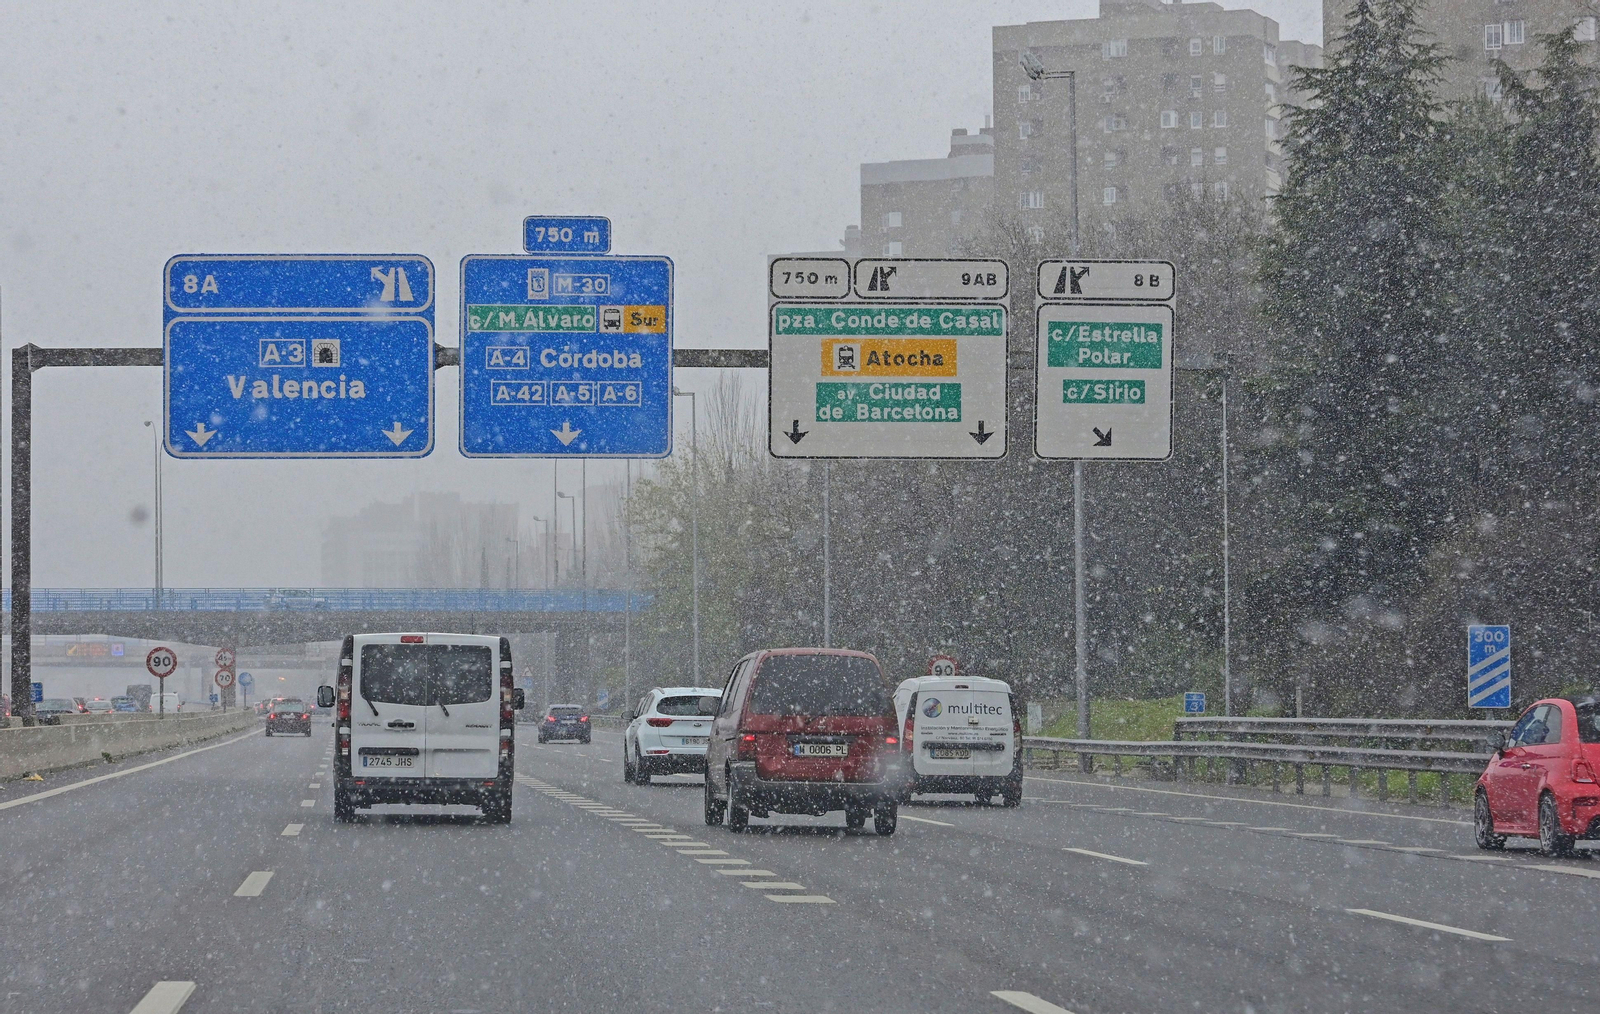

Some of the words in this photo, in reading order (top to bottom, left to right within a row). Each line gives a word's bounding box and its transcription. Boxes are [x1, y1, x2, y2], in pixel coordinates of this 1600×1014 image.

[535, 227, 573, 243] 750
[584, 231, 600, 244] m
[183, 275, 219, 294] 8A
[557, 278, 606, 292] M-30
[782, 272, 819, 284] 750
[824, 275, 838, 284] m
[961, 273, 997, 285] 9AB
[630, 312, 659, 327] Sur
[831, 312, 899, 328] Conde
[905, 312, 931, 328] de
[939, 312, 1000, 329] Casal
[263, 343, 303, 363] A-3
[489, 351, 526, 366] A-4
[540, 346, 642, 368] Córdoba
[866, 350, 944, 366] Atocha
[1078, 347, 1132, 364] Polar
[227, 374, 366, 399] Valencia
[496, 385, 543, 401] A-42
[555, 385, 591, 401] A-5
[602, 385, 638, 401] A-6
[869, 383, 941, 400] Ciudad
[819, 403, 843, 419] de
[856, 403, 958, 420] Barcelona
[1474, 631, 1504, 642] 300
[1484, 644, 1496, 653] m
[153, 656, 171, 667] 90
[934, 664, 953, 676] 90
[219, 674, 231, 682] 70
[948, 702, 1003, 715] multitec
[369, 757, 392, 766] 2745
[395, 757, 412, 767] JHS
